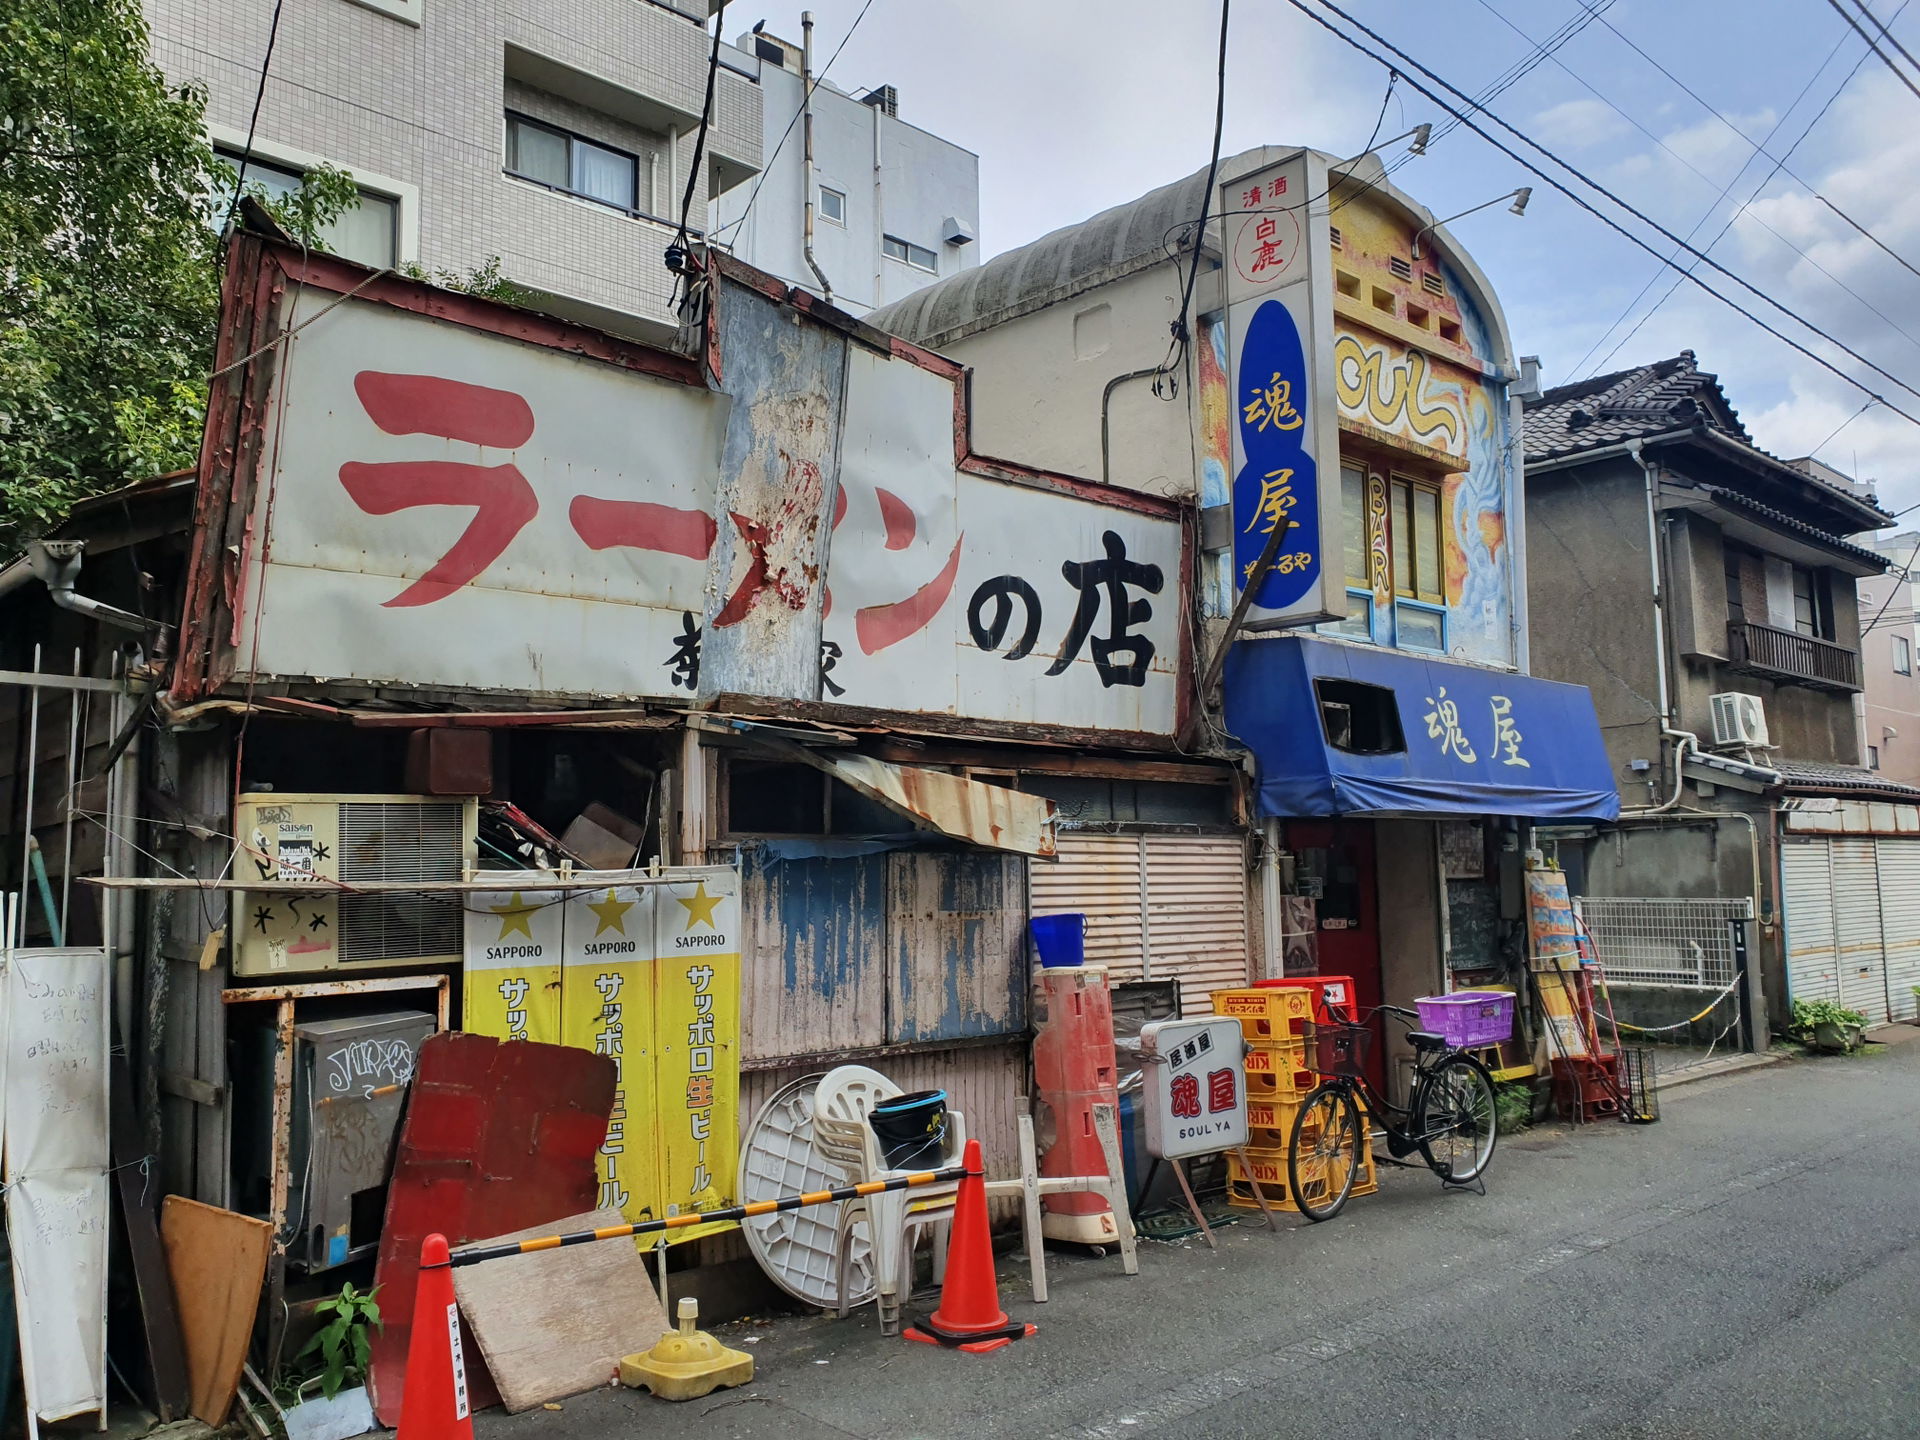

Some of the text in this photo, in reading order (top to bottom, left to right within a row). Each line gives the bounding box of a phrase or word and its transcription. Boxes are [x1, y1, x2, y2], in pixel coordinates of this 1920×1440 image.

[1242, 175, 1287, 208] 清酒
[1251, 216, 1284, 273] 白鹿
[1243, 372, 1304, 534] 魂屋
[1369, 476, 1389, 592] BAR
[1423, 686, 1531, 768] 魂屋
[486, 945, 543, 960] SAPPORO
[584, 940, 636, 955] SAPPORO
[675, 934, 726, 949] SAPPORO
[1169, 1032, 1211, 1068] 居酒屋
[594, 972, 630, 1210] サッポビール
[685, 964, 715, 1196] サッポロ生ビール
[1171, 1067, 1237, 1118] 魂屋
